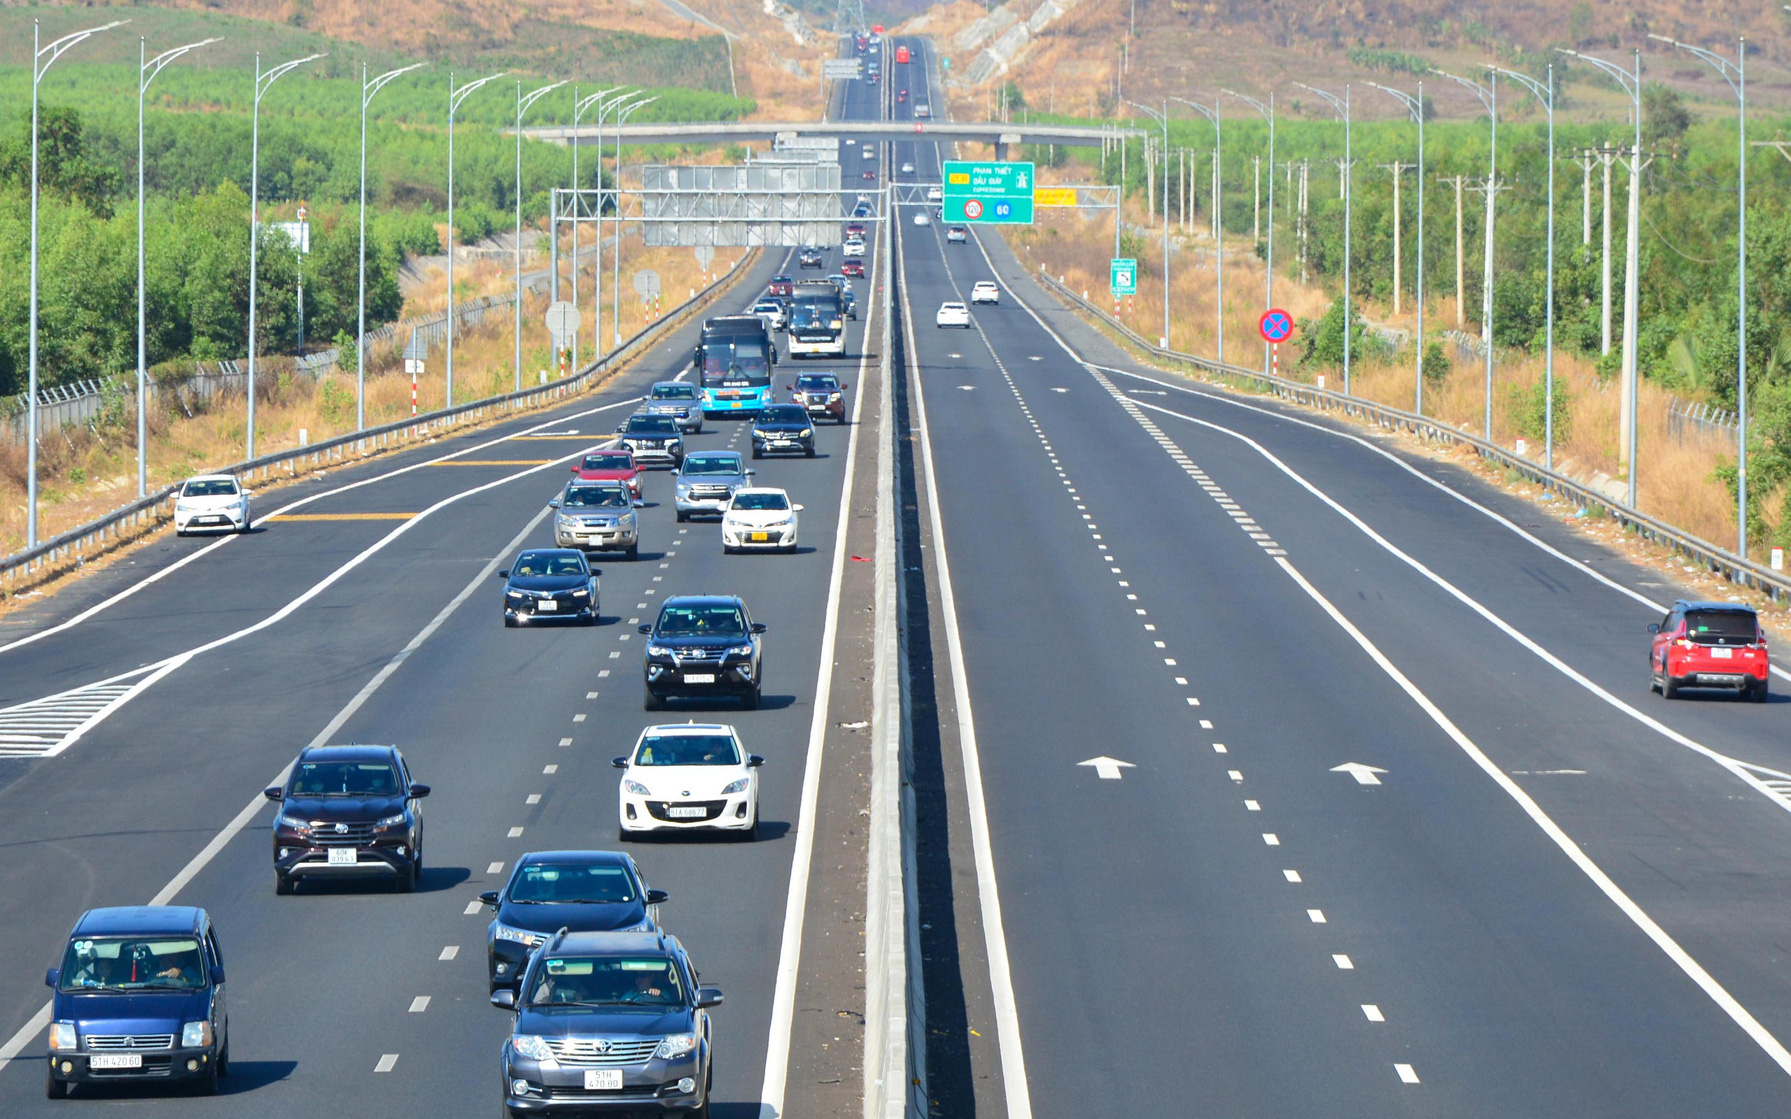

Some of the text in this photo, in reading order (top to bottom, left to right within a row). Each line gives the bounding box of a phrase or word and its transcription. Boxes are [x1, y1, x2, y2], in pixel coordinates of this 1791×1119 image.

[967, 204, 981, 214] 120
[92, 1056, 108, 1066] 51H
[595, 1071, 612, 1079] 51H
